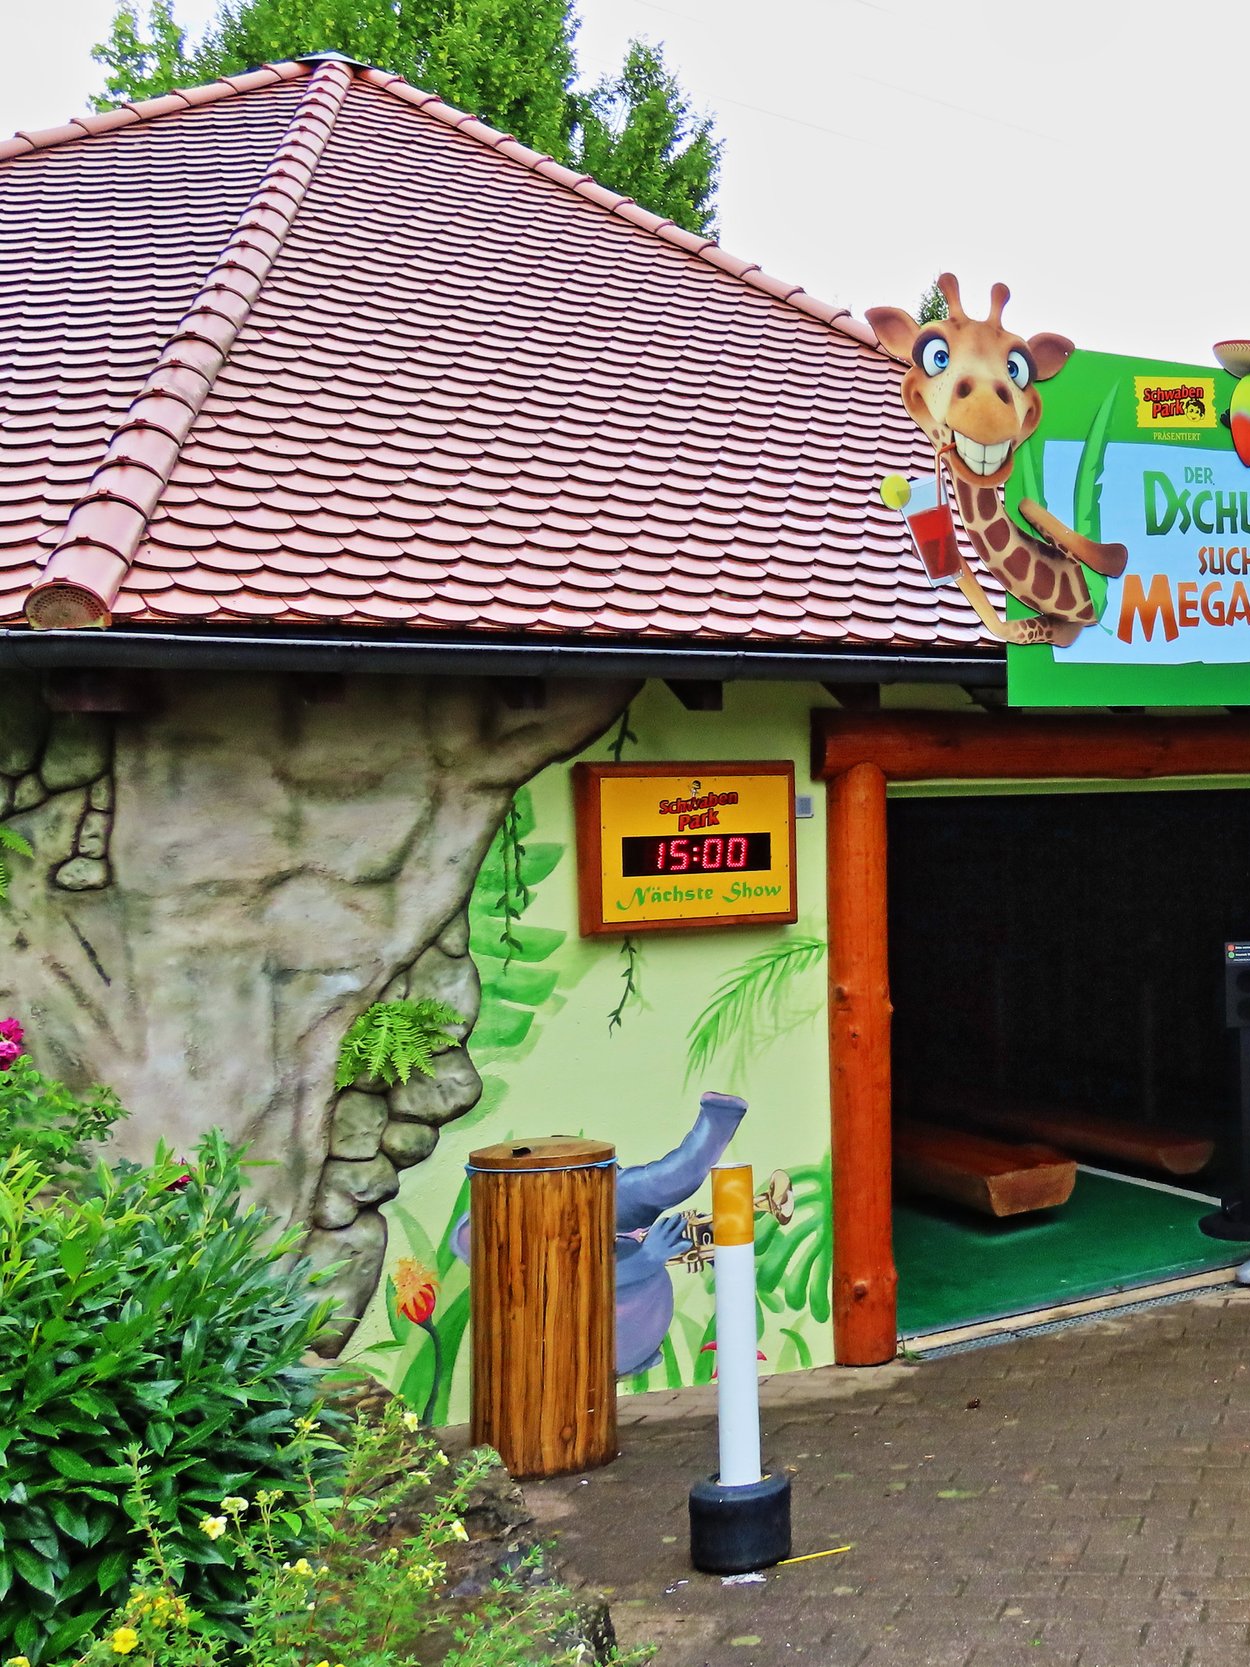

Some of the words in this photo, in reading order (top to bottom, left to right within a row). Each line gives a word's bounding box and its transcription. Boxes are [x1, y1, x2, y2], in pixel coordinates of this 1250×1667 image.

[1143, 384, 1204, 402] Schwaben
[1152, 400, 1185, 419] Park
[1153, 432, 1201, 441] PRÄSENTIERT
[1184, 466, 1213, 484] DER
[659, 790, 739, 815] Schwaben
[678, 808, 720, 832] Park
[656, 837, 748, 871] 15:00
[616, 884, 714, 911] Nächste
[722, 881, 782, 903] Show
